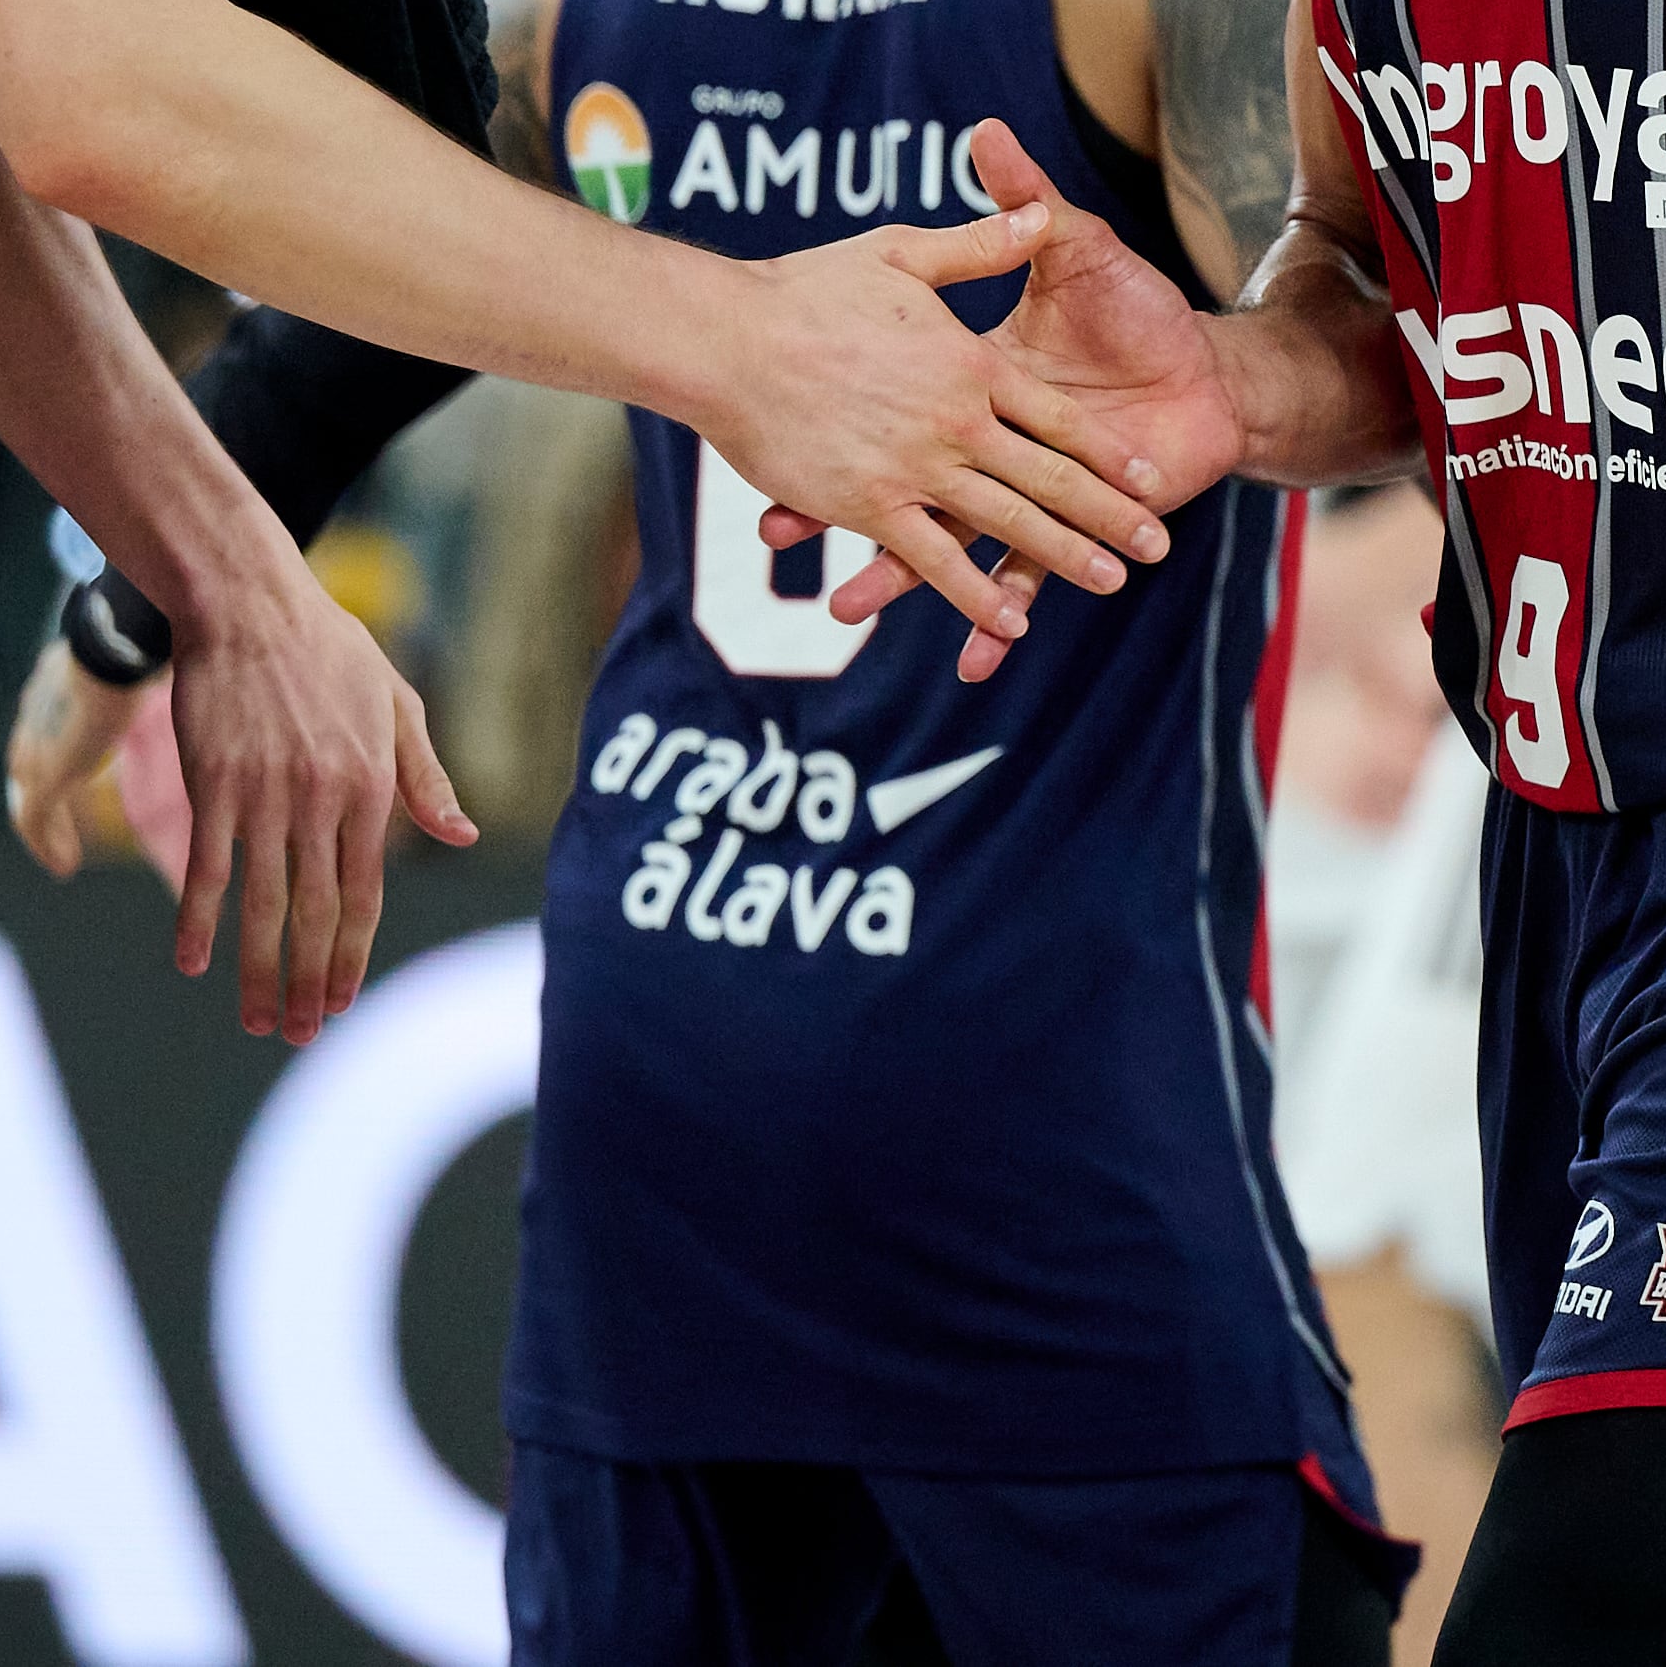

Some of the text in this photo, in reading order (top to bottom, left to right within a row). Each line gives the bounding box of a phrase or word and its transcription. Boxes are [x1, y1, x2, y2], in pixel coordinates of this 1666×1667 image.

[1499, 553, 1571, 790] 9
[590, 712, 857, 843] araba
[622, 812, 916, 957] álava
